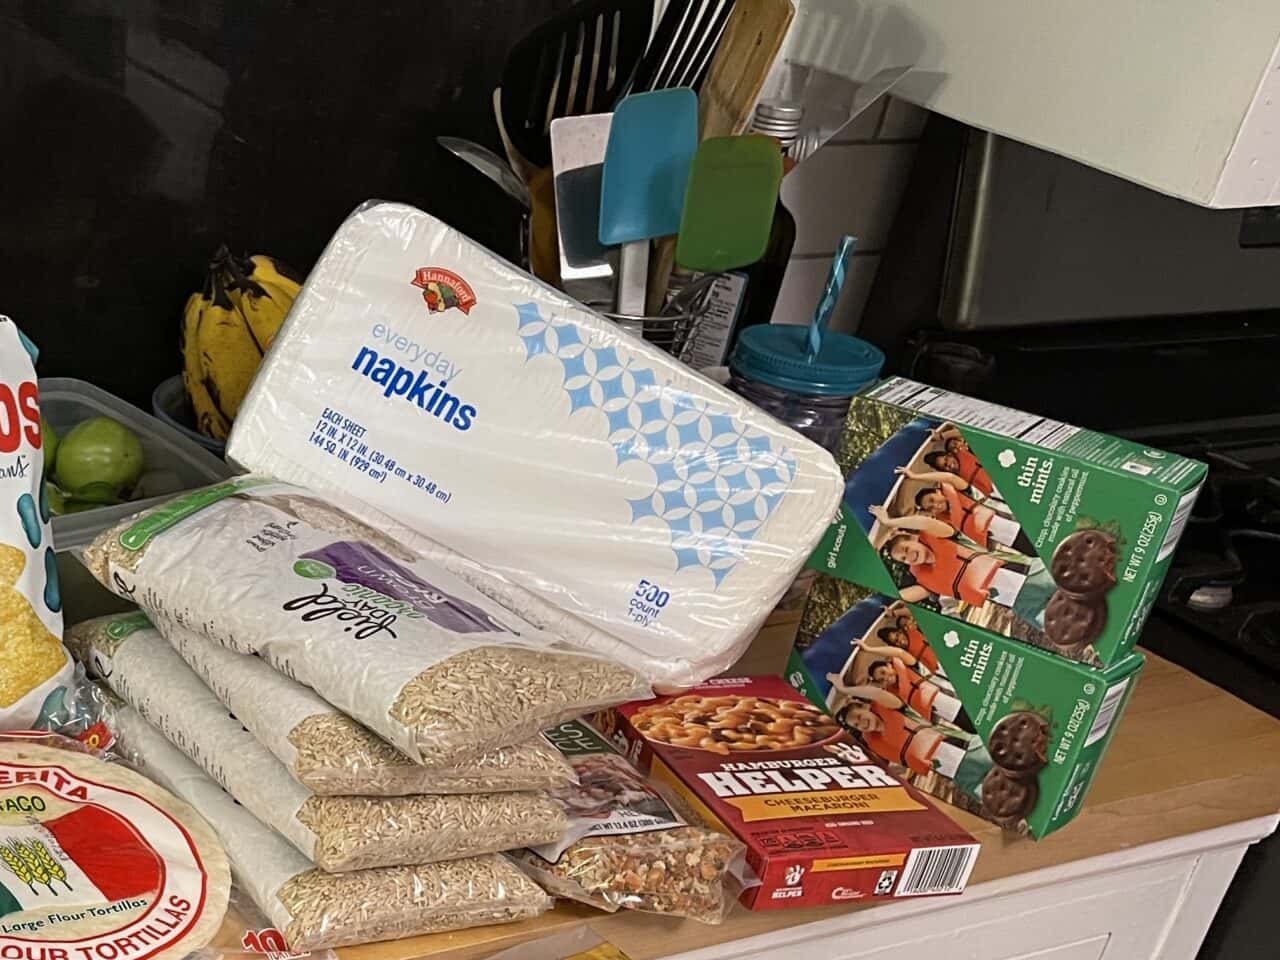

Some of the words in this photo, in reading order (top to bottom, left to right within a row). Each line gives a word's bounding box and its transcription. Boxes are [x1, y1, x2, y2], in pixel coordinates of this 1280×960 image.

[423, 271, 471, 303] Hannaford
[372, 323, 463, 382] everyday
[352, 346, 476, 431] napkins
[322, 408, 342, 425] EACH
[341, 419, 367, 439] SHEET
[308, 431, 325, 447] 144
[349, 455, 370, 473] (929
[315, 420, 327, 432] 12
[338, 434, 347, 444] X
[346, 437, 359, 451] 12
[368, 450, 396, 472] (30.48
[394, 467, 407, 479] cm
[412, 475, 437, 494] 30.48
[435, 490, 452, 504] cm)
[1017, 457, 1038, 487] thin
[828, 552, 837, 569] girl
[833, 525, 847, 552] scouts
[1129, 553, 1143, 566] WT
[1123, 566, 1137, 582] NET
[635, 578, 670, 608] 500
[282, 583, 397, 639] field
[344, 598, 389, 620] DAY
[627, 607, 651, 627] 1-ply
[629, 597, 661, 618] count
[960, 640, 979, 667] thin
[1053, 749, 1067, 764] NET
[1059, 737, 1071, 750] WT
[720, 757, 841, 772] HAMBURGER
[697, 765, 901, 797] HELPER
[764, 791, 881, 807] CHEESEBURGER
[789, 801, 870, 813] MACARONI
[1, 919, 45, 934] Large
[48, 910, 86, 925] Flour
[87, 897, 148, 918] Tortillas
[242, 929, 287, 953] 10
